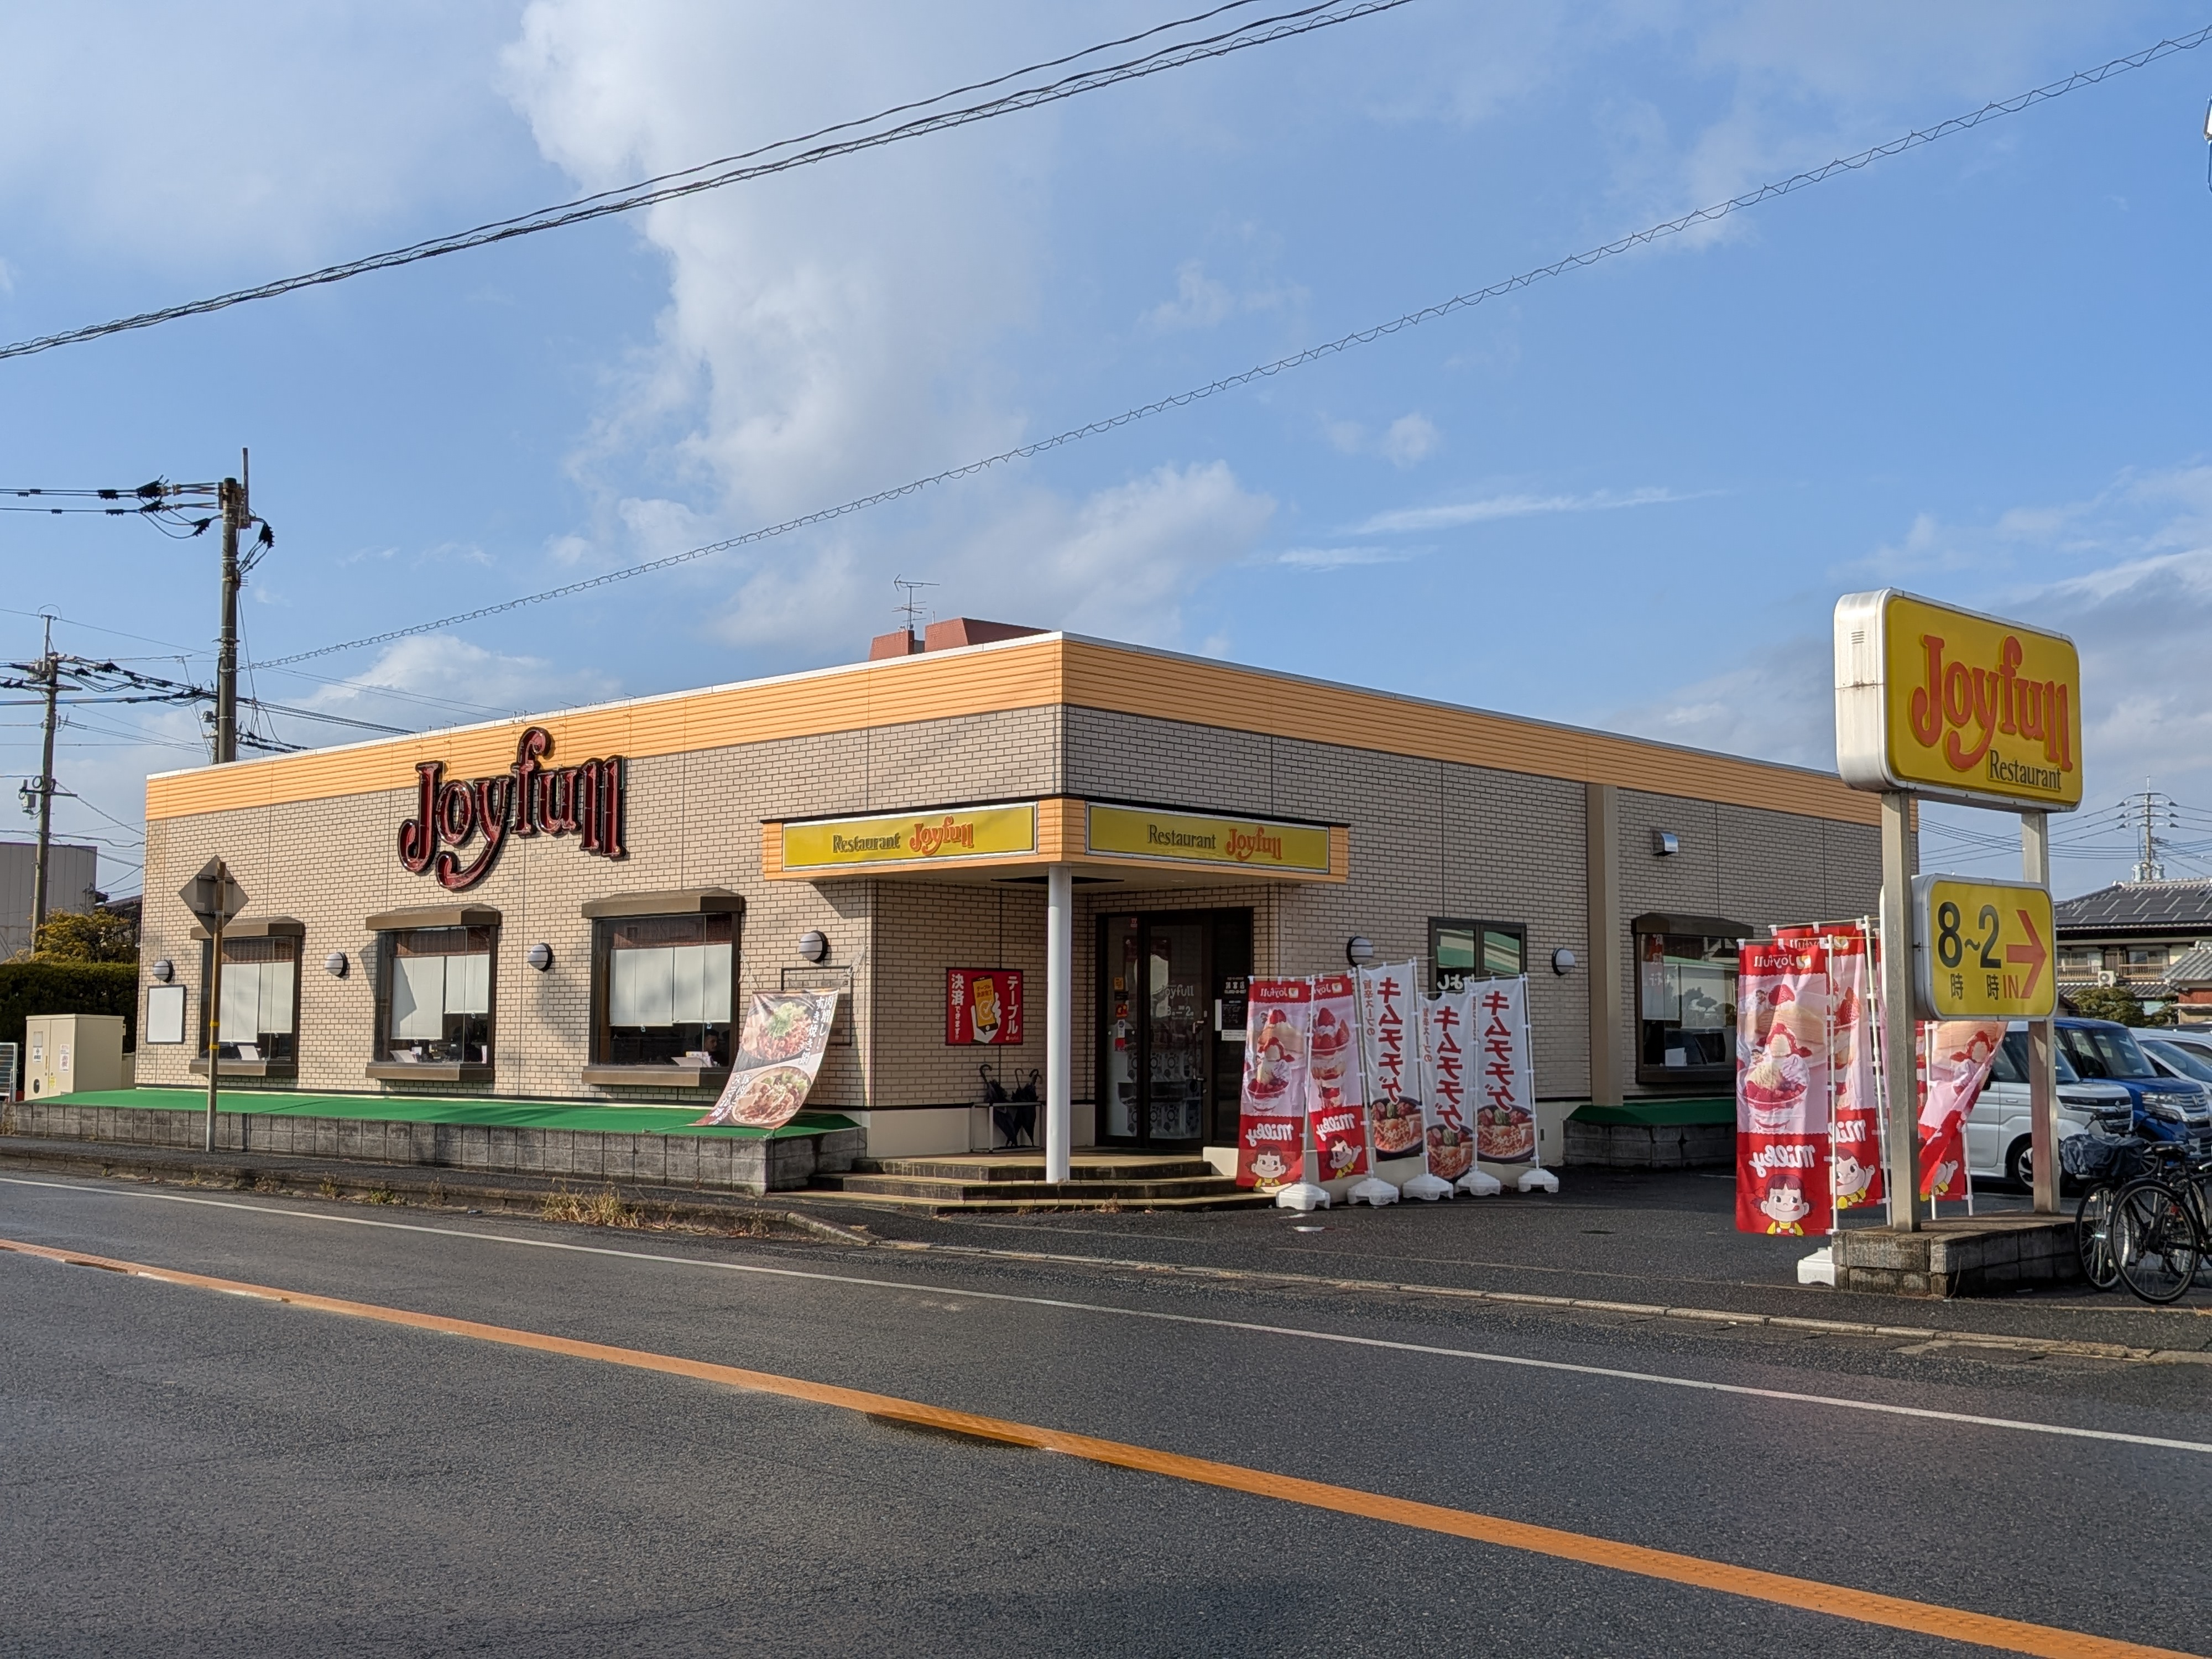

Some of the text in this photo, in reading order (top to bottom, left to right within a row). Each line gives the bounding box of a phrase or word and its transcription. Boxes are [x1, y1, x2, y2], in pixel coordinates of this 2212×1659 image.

[1911, 634, 2073, 771] Joyfull
[1989, 749, 2061, 790] Restaurant
[398, 727, 627, 890] Joyfull
[833, 815, 974, 855] Restaurant Joyfull
[1147, 824, 1282, 862] Restaurant Joyfull
[1007, 976, 1019, 1034] テーブル
[1950, 973, 2019, 1000] 時 時 IN
